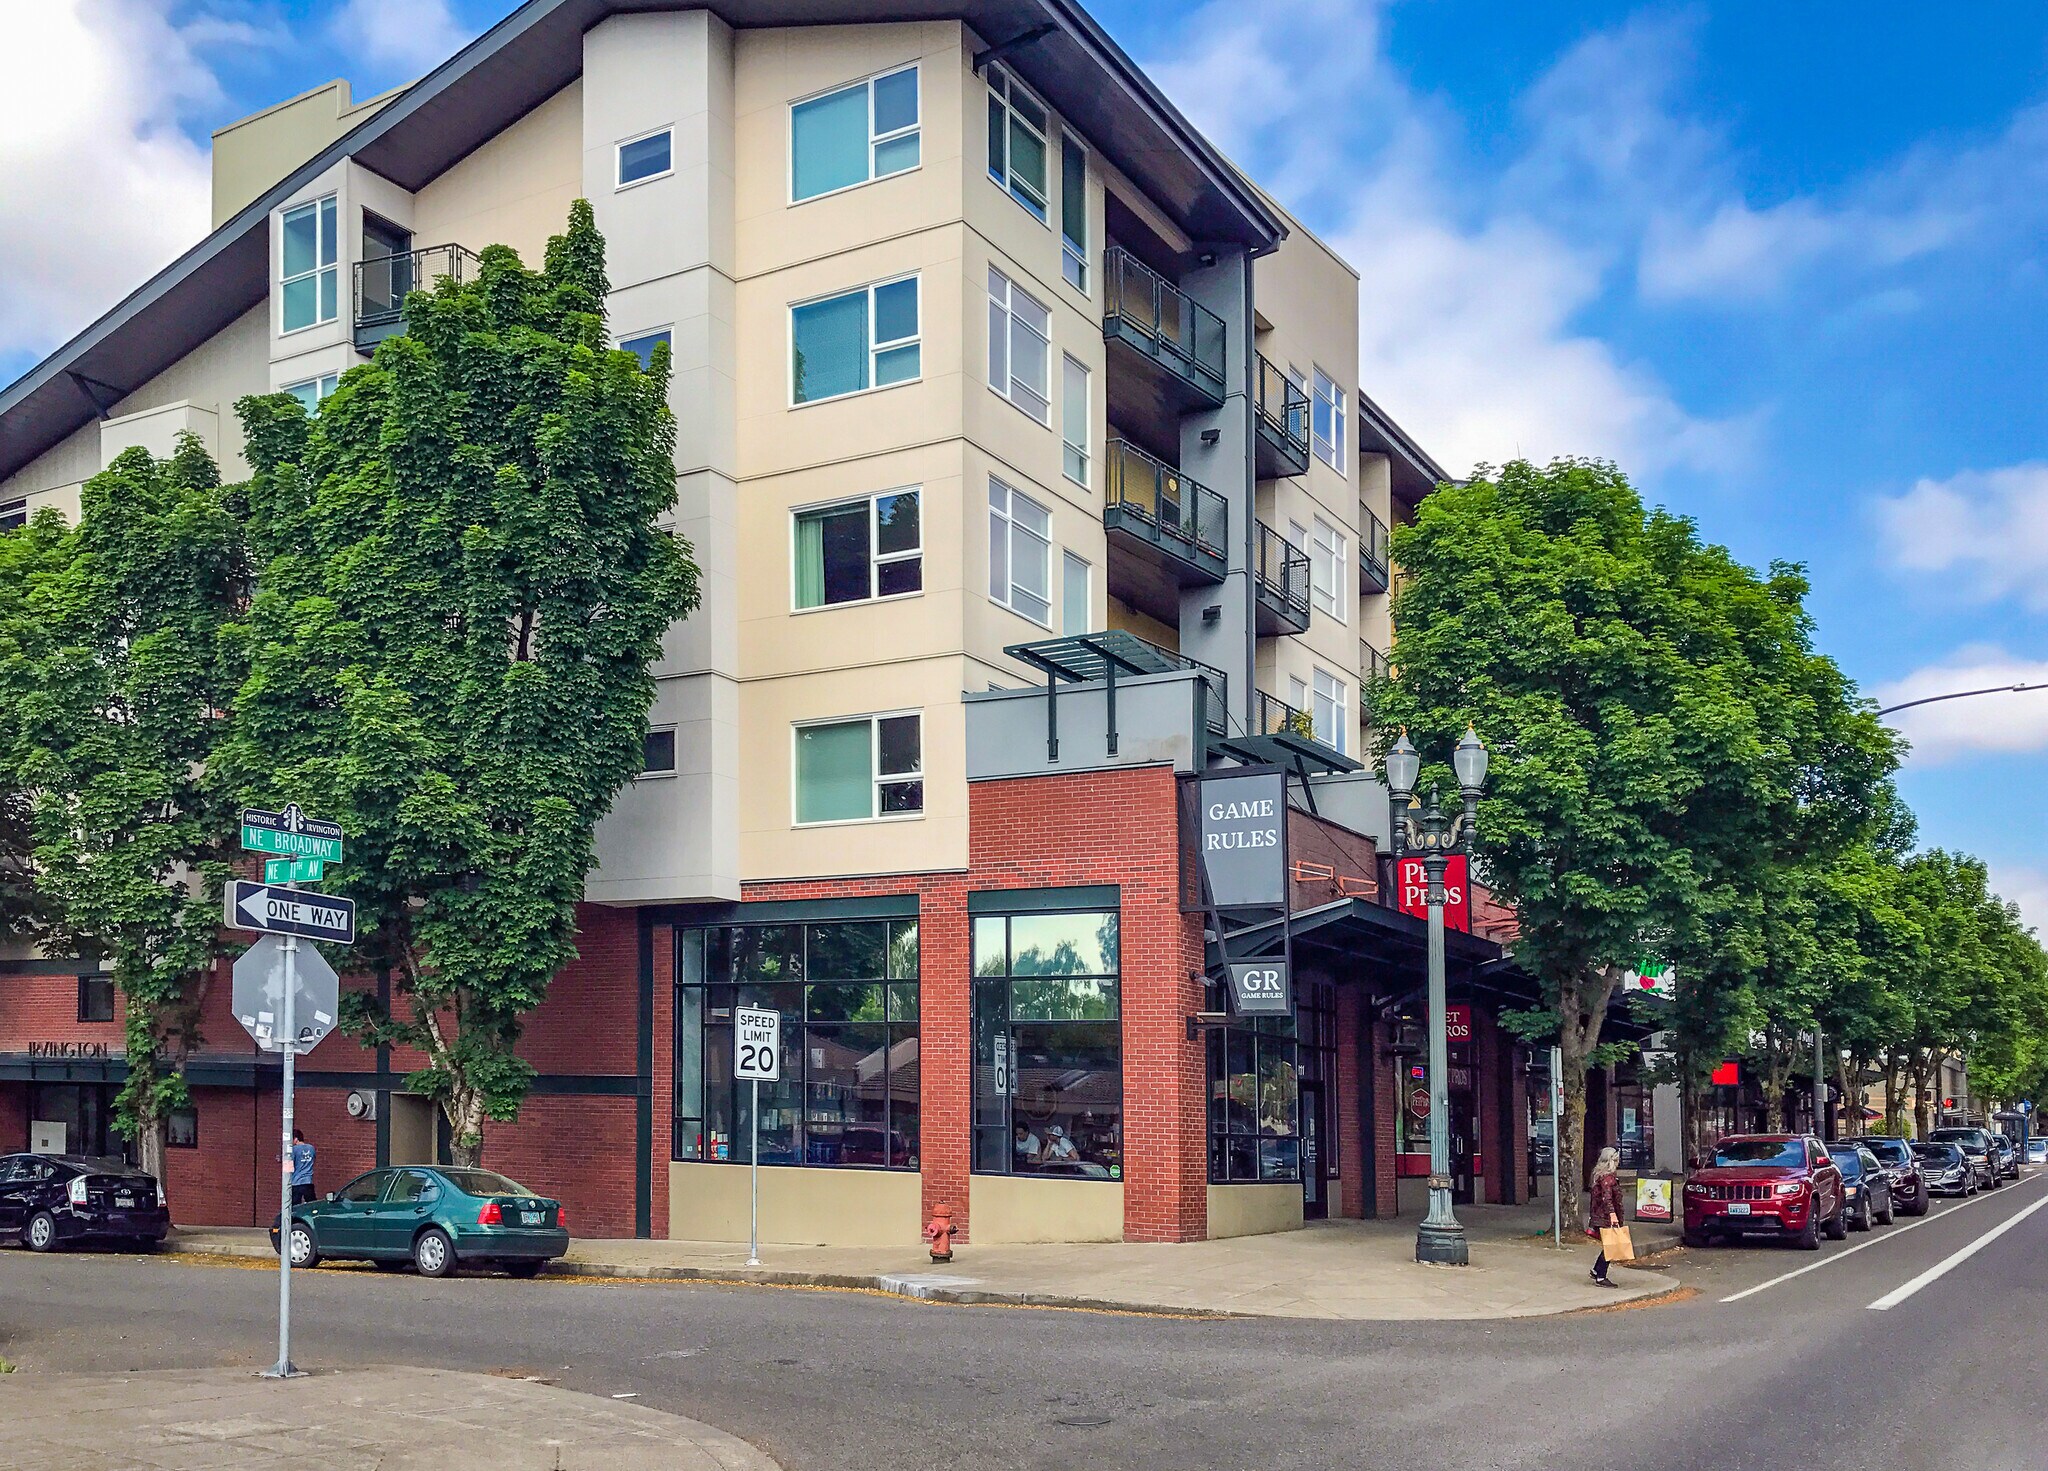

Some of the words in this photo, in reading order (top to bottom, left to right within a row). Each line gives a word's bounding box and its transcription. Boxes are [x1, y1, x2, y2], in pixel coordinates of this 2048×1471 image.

[1209, 799, 1274, 821] GAME
[246, 813, 277, 826] HISTORIC
[306, 823, 340, 836] IRVINGTON
[249, 828, 264, 847] NE
[274, 832, 334, 857] BROADWAY
[1207, 829, 1277, 850] RULES
[267, 863, 279, 880] NE
[307, 860, 319, 878] AV
[267, 900, 301, 920] ONE
[311, 907, 345, 928] WAY
[1243, 970, 1281, 991] GR
[740, 1014, 775, 1028] SPEED
[1446, 1012, 1461, 1023] ET
[743, 1029, 772, 1043] LIMIT
[1446, 1025, 1469, 1037] ROS
[28, 1041, 108, 1058] IRVINGTON
[740, 1044, 774, 1072] 20
